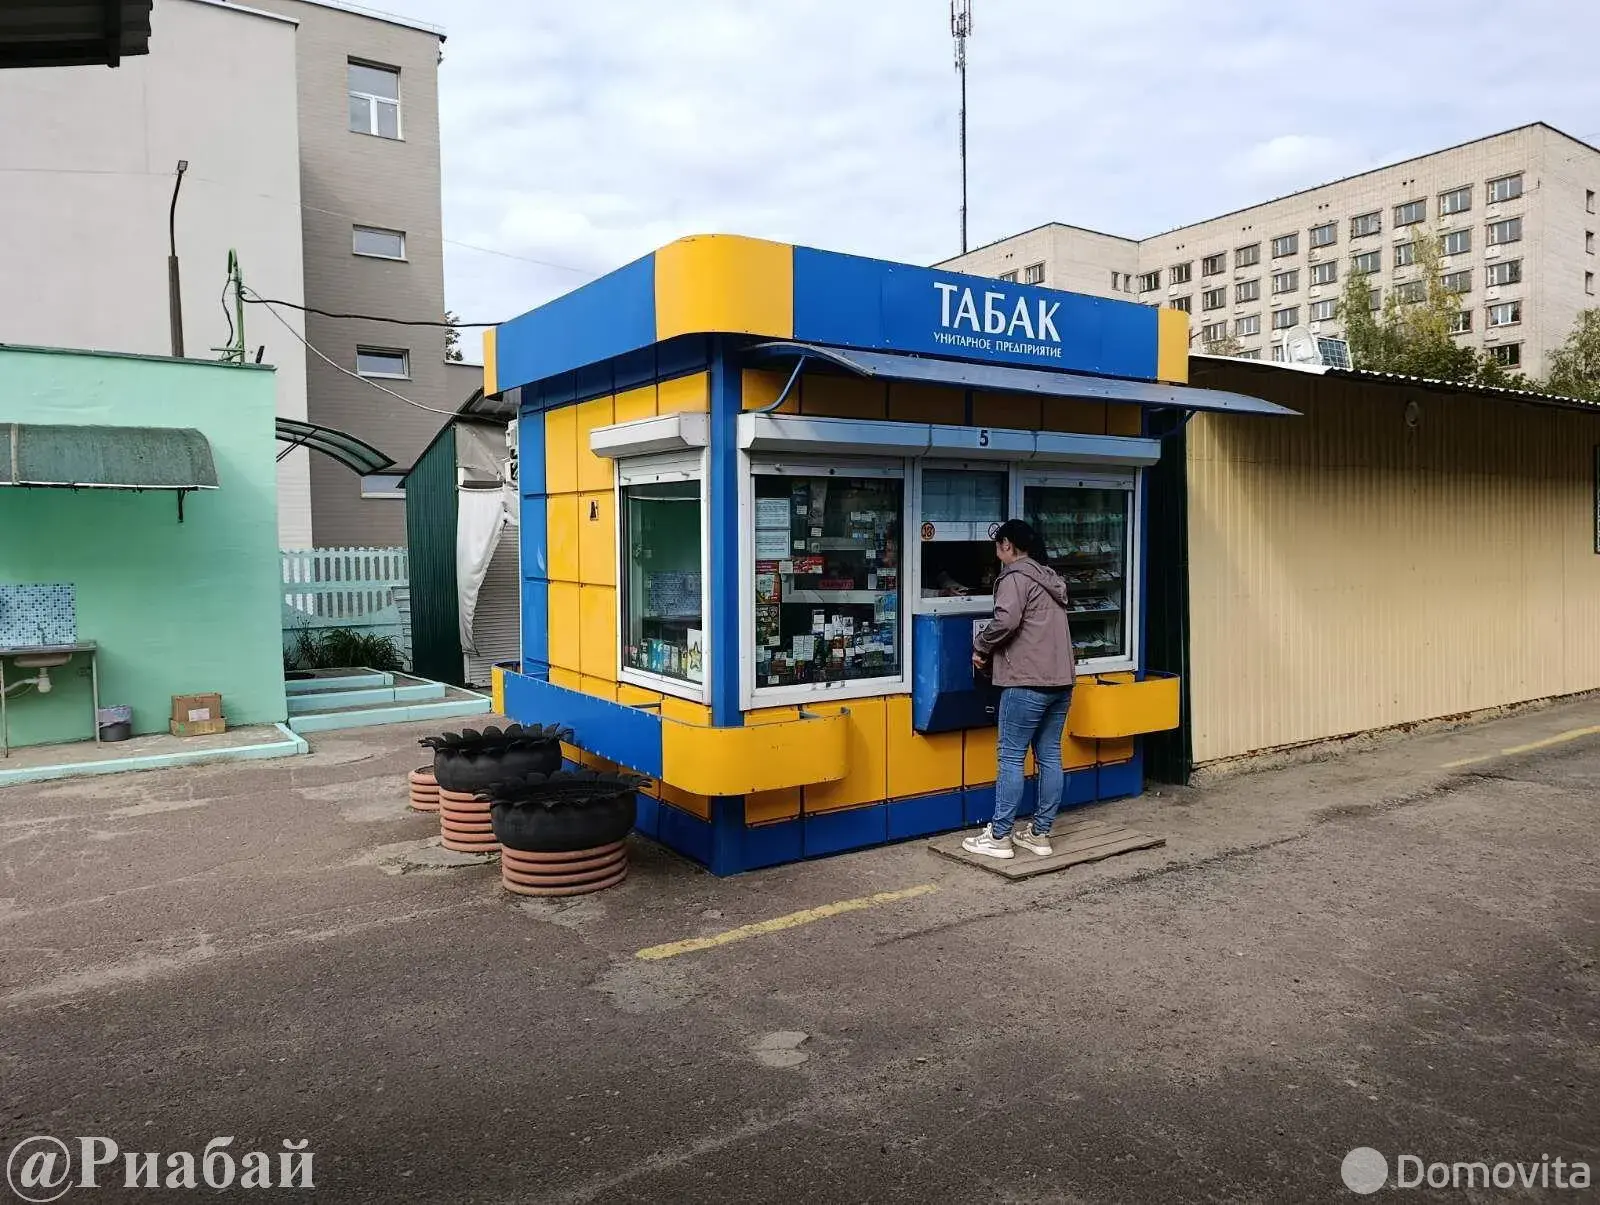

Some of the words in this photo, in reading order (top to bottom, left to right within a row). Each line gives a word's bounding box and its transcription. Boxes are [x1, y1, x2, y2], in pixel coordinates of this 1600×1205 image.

[933, 281, 1062, 343] ТАБАК
[933, 331, 991, 350] УНИТАРНОЕ
[996, 340, 1062, 358] ПРЕДПРИЯТИЕ
[979, 429, 989, 446] 5
